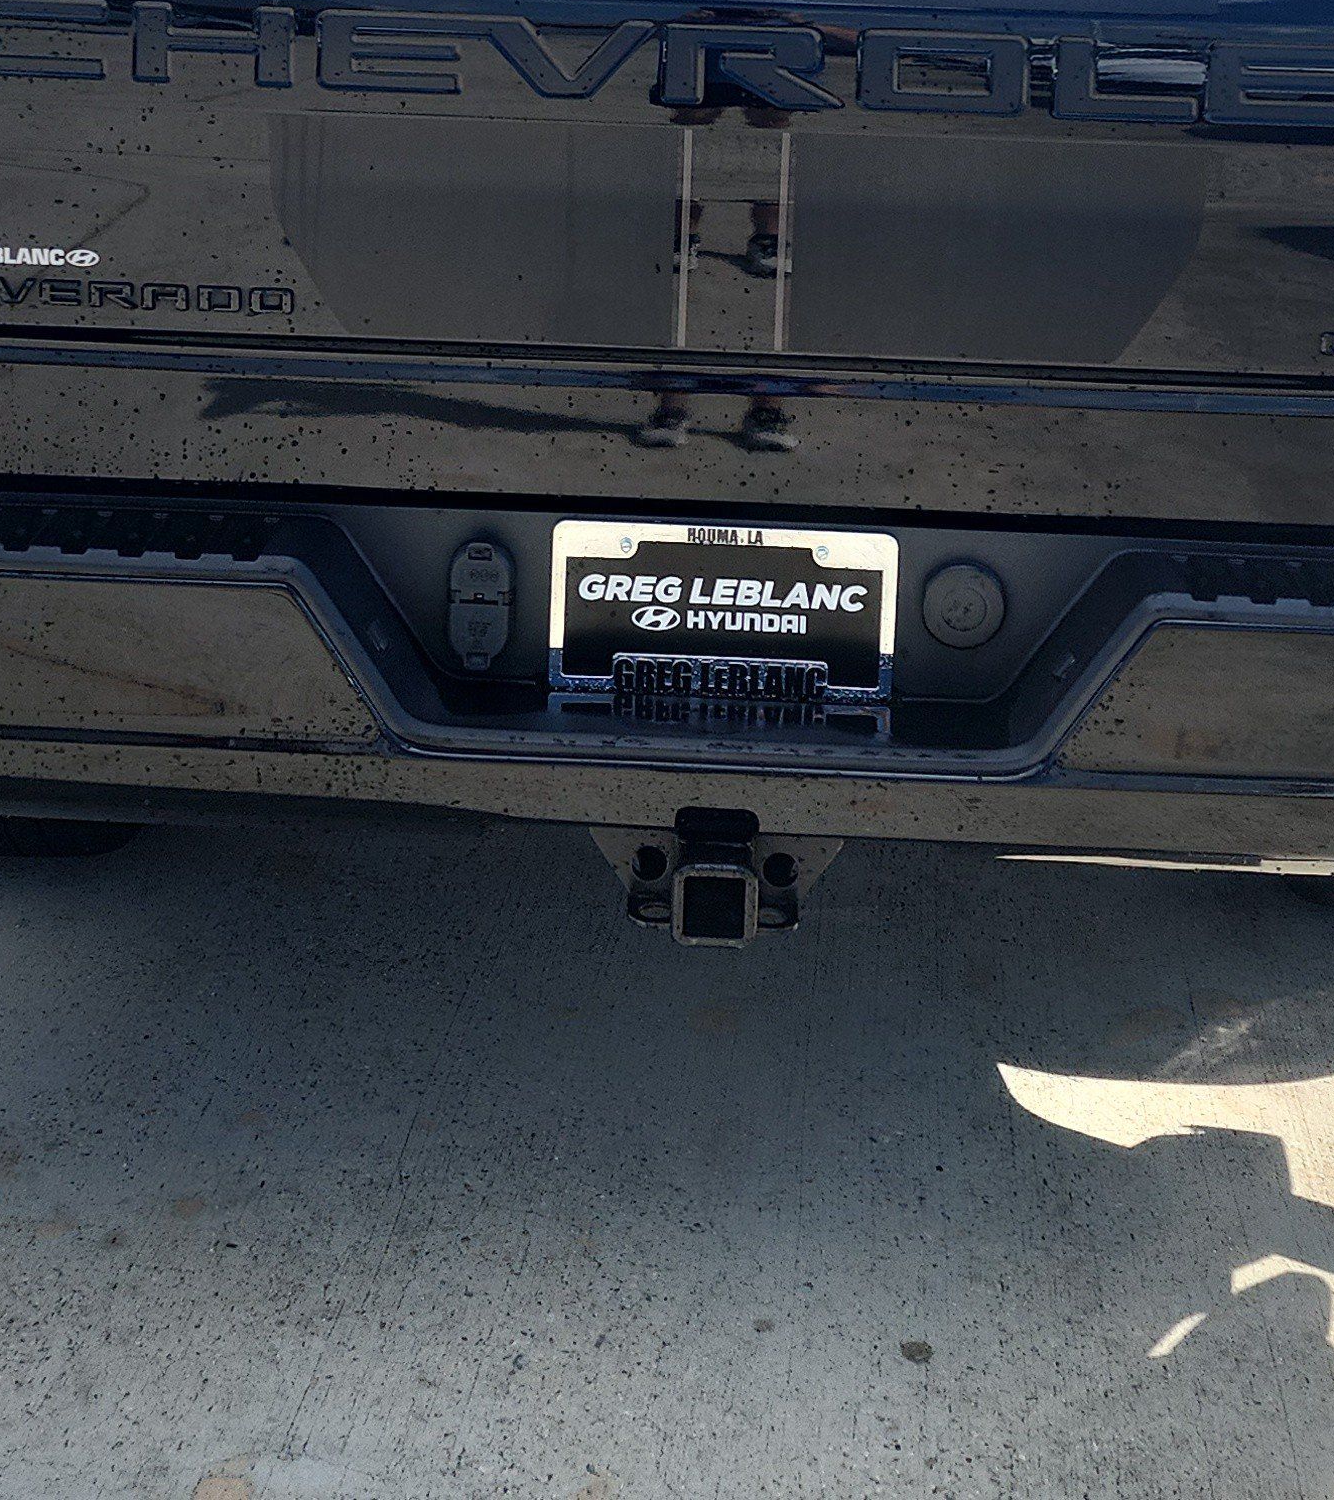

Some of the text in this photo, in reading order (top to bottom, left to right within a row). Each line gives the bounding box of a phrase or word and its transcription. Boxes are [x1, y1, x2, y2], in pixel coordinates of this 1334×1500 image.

[748, 530, 764, 545] LA
[578, 573, 869, 613] GREG LEBLANC
[687, 610, 807, 635] HYUNDAI
[614, 658, 693, 695] GREG
